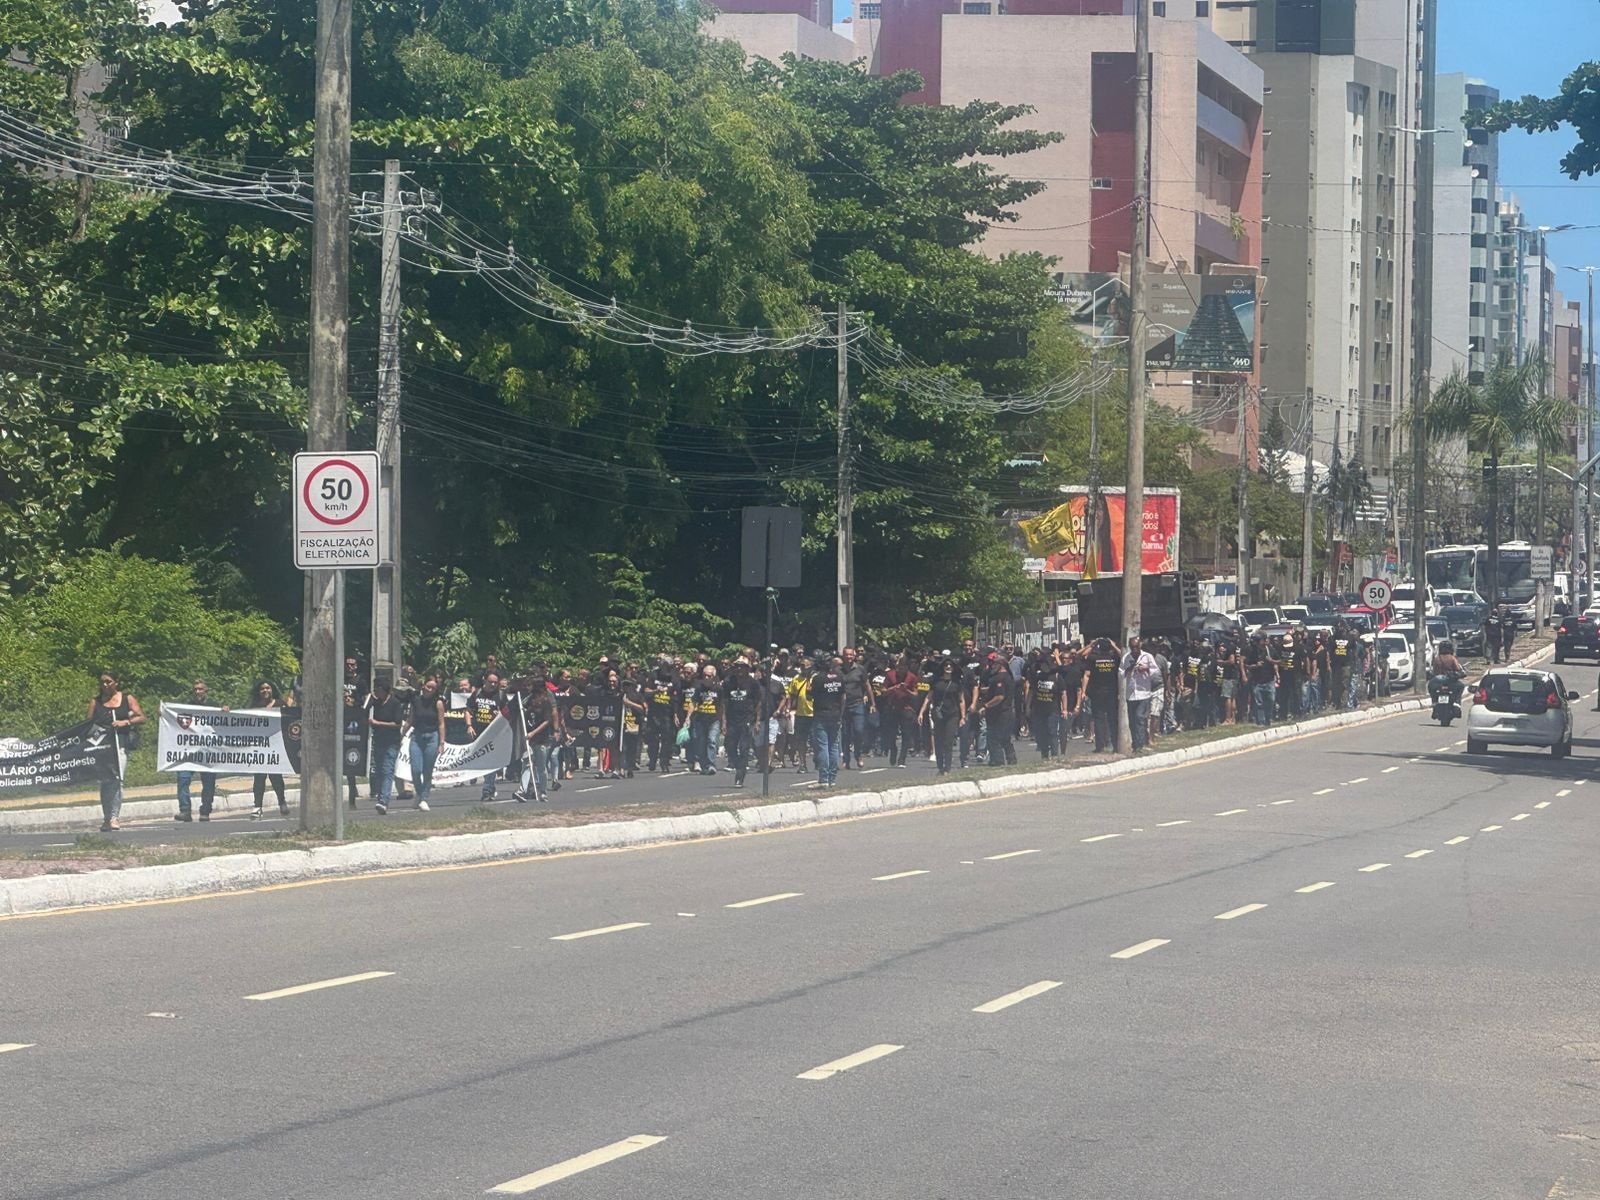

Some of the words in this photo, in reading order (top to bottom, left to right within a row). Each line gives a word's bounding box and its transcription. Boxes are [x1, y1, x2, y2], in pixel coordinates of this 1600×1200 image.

[321, 478, 352, 500] 50
[325, 503, 348, 511] km/h
[300, 536, 374, 548] FISCALIZAÇÃO
[305, 548, 370, 558] ELETRÔNICA
[1369, 587, 1385, 599] 50
[230, 716, 270, 728] CIVIL/PB
[224, 735, 271, 748] RECUPERA
[166, 748, 203, 763] SALÁRIO
[205, 750, 265, 767] VALORIZAÇÃO
[39, 764, 51, 773] do
[53, 756, 96, 771] Nordeste
[35, 771, 71, 785] Penais!
